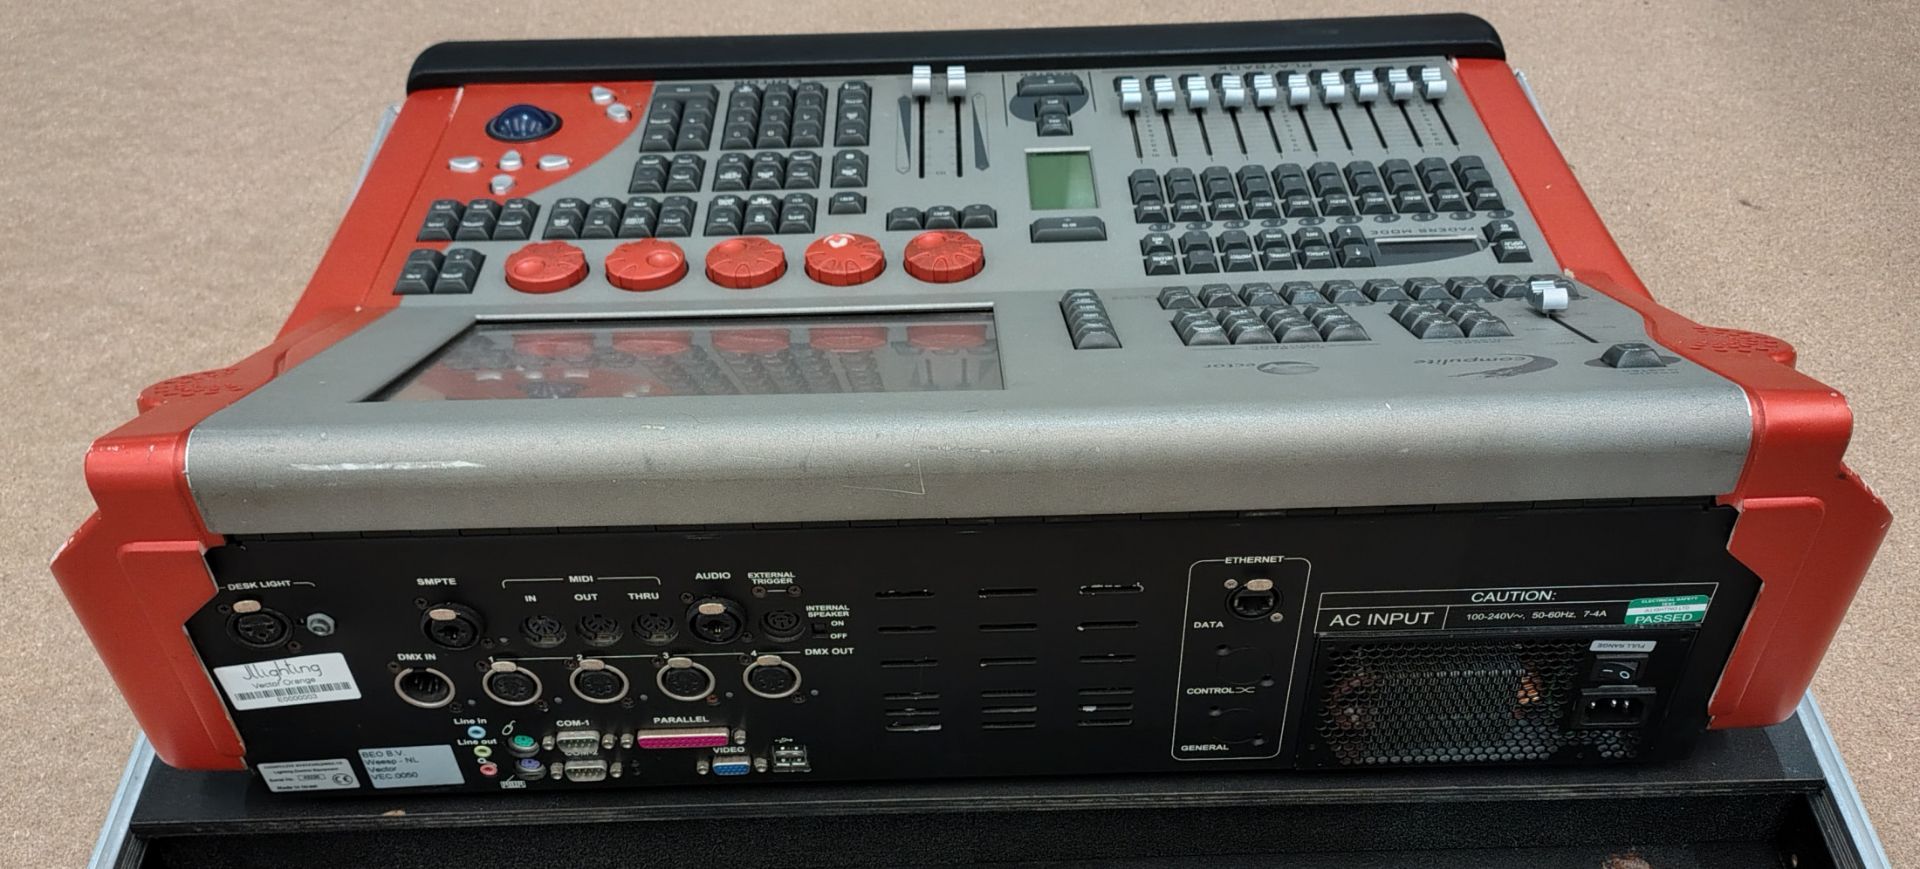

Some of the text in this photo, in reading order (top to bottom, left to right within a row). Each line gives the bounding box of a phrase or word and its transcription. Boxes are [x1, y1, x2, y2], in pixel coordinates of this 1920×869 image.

[1369, 228, 1413, 236] MODE
[1224, 555, 1284, 565] ETHERNET
[568, 574, 594, 583] MIDI
[695, 571, 731, 580] AUDIO
[747, 571, 796, 579] EXTERNAL
[227, 580, 291, 591] DESK LIGHT
[416, 577, 457, 586] SMPTE
[525, 595, 537, 603] IN
[574, 593, 598, 602] OUT
[627, 592, 660, 601] THRU
[1471, 590, 1557, 603] CAUTION:
[805, 604, 850, 612] INTERNAL
[1329, 611, 1434, 627] AC INPUT
[1634, 613, 1693, 625] PASSED
[1193, 621, 1224, 629] DATA
[829, 632, 848, 640] OFF
[805, 647, 855, 656] DMX OUT
[397, 652, 436, 661] DMX IN
[251, 677, 317, 689] Vector Orange
[1186, 686, 1235, 695] CONTROL
[453, 717, 487, 725] Line in
[556, 719, 590, 727] COM-1
[653, 715, 710, 724] PARALLEL
[713, 746, 745, 754] VIDEO
[1180, 743, 1229, 752] GENERAL
